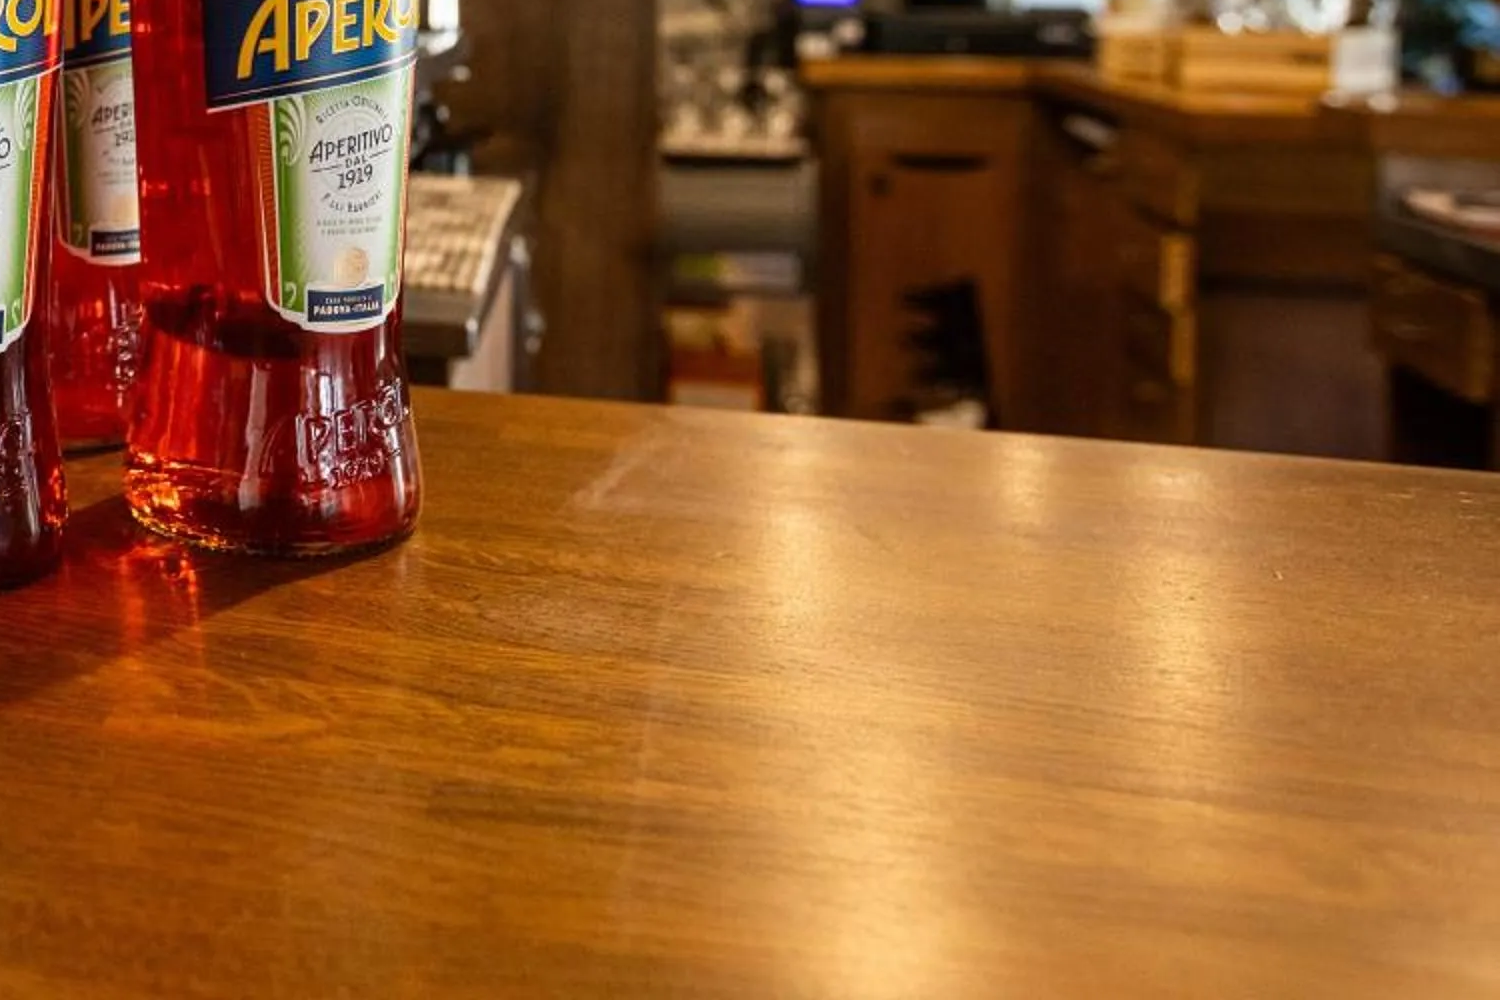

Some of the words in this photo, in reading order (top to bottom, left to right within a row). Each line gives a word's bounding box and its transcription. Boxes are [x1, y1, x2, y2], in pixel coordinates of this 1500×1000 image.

[309, 123, 393, 164] APERITIVO
[345, 154, 368, 168] DAL
[337, 164, 373, 189] 1919
